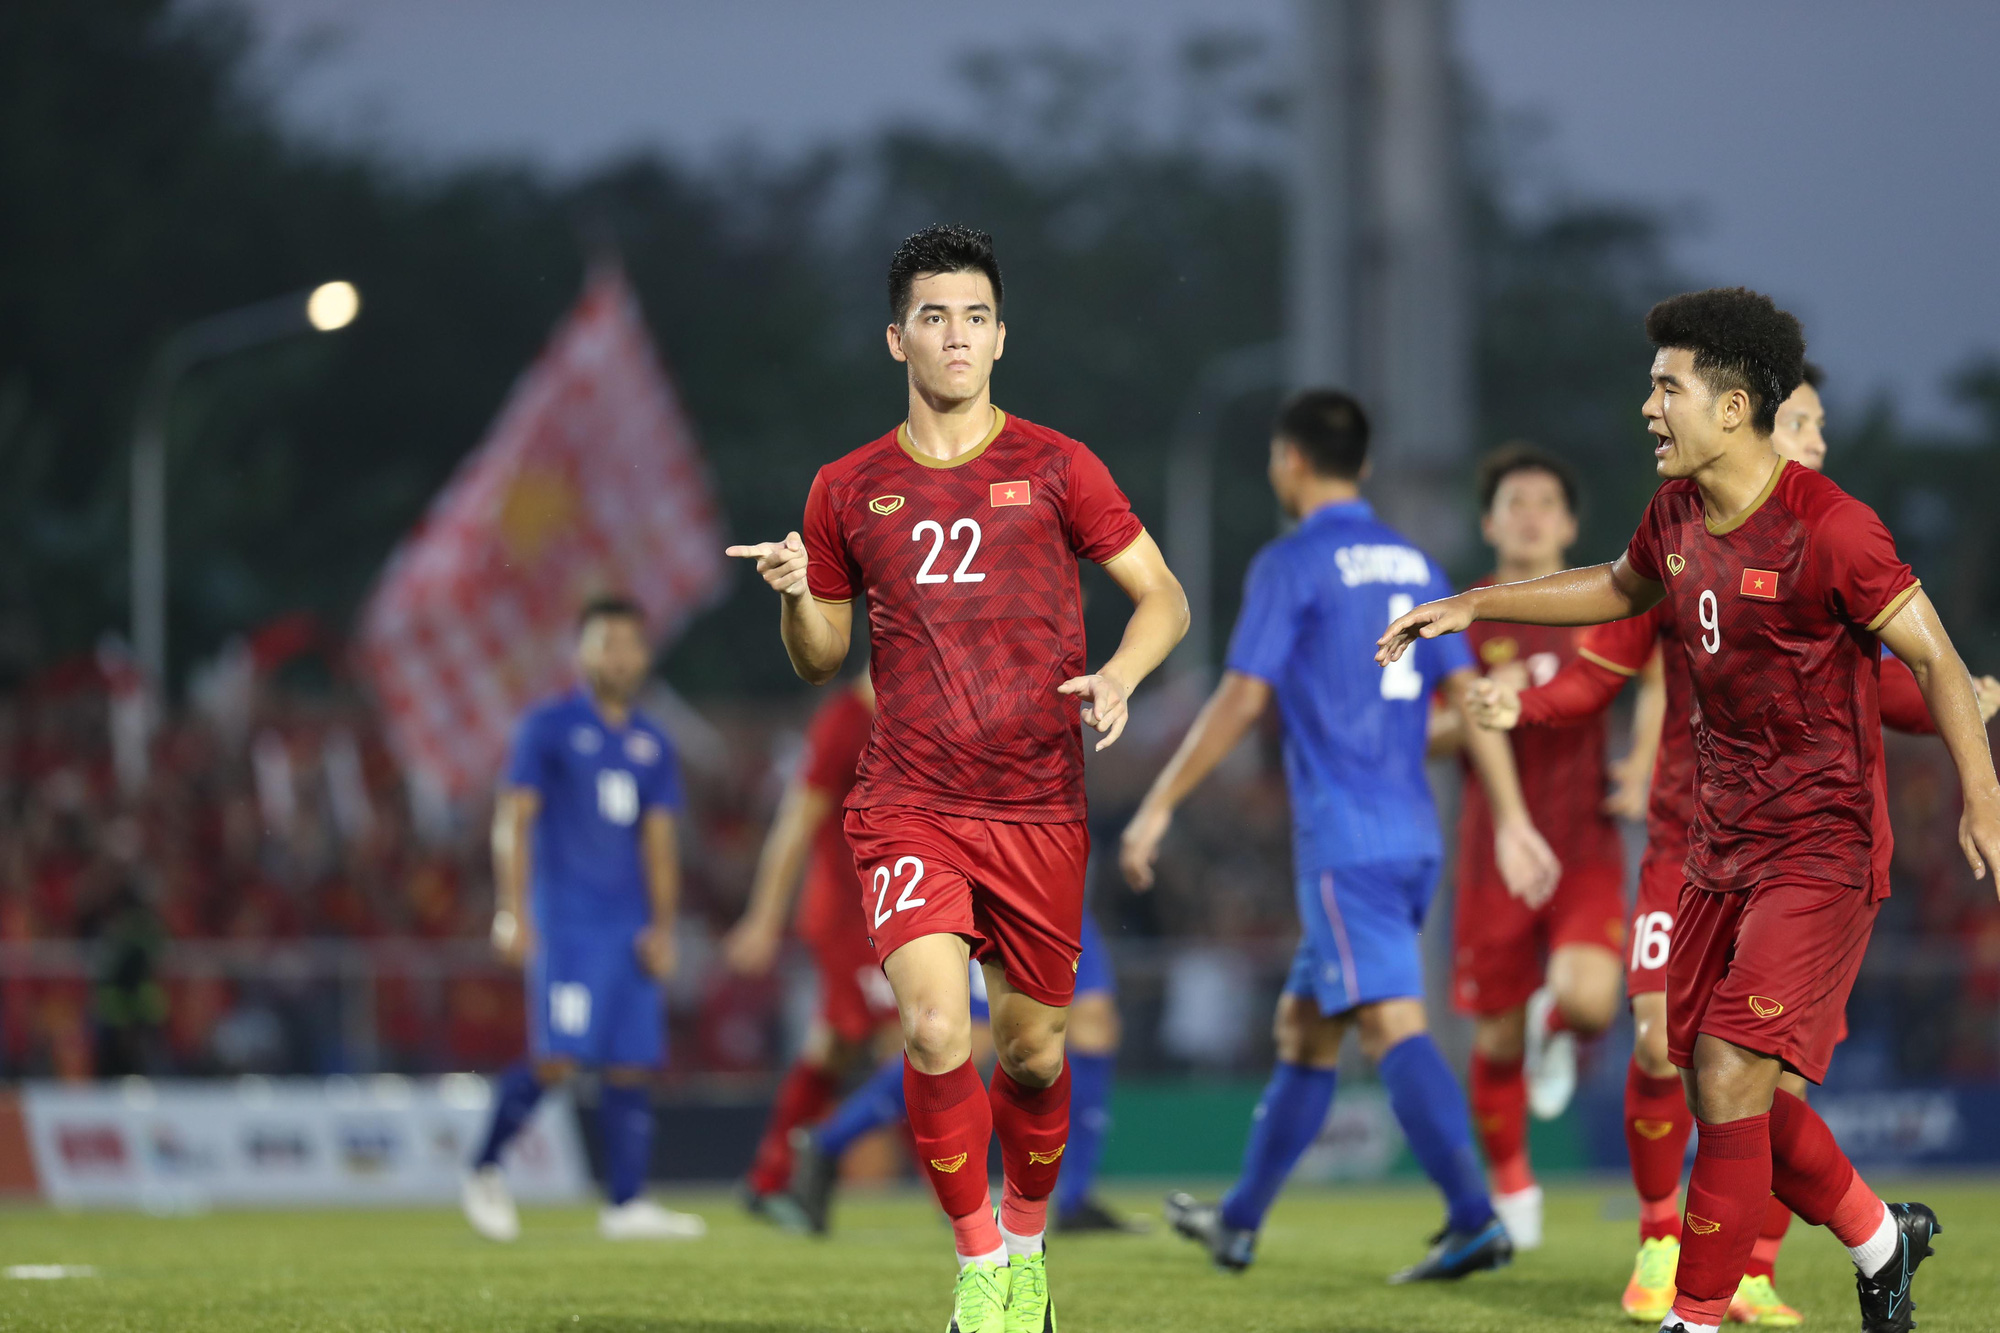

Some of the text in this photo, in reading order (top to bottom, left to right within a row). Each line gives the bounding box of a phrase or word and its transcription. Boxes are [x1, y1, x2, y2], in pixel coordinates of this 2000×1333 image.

[912, 517, 986, 585] 22
[1698, 589, 1721, 655] 9
[872, 855, 926, 930] 22
[1631, 910, 1674, 973] 16
